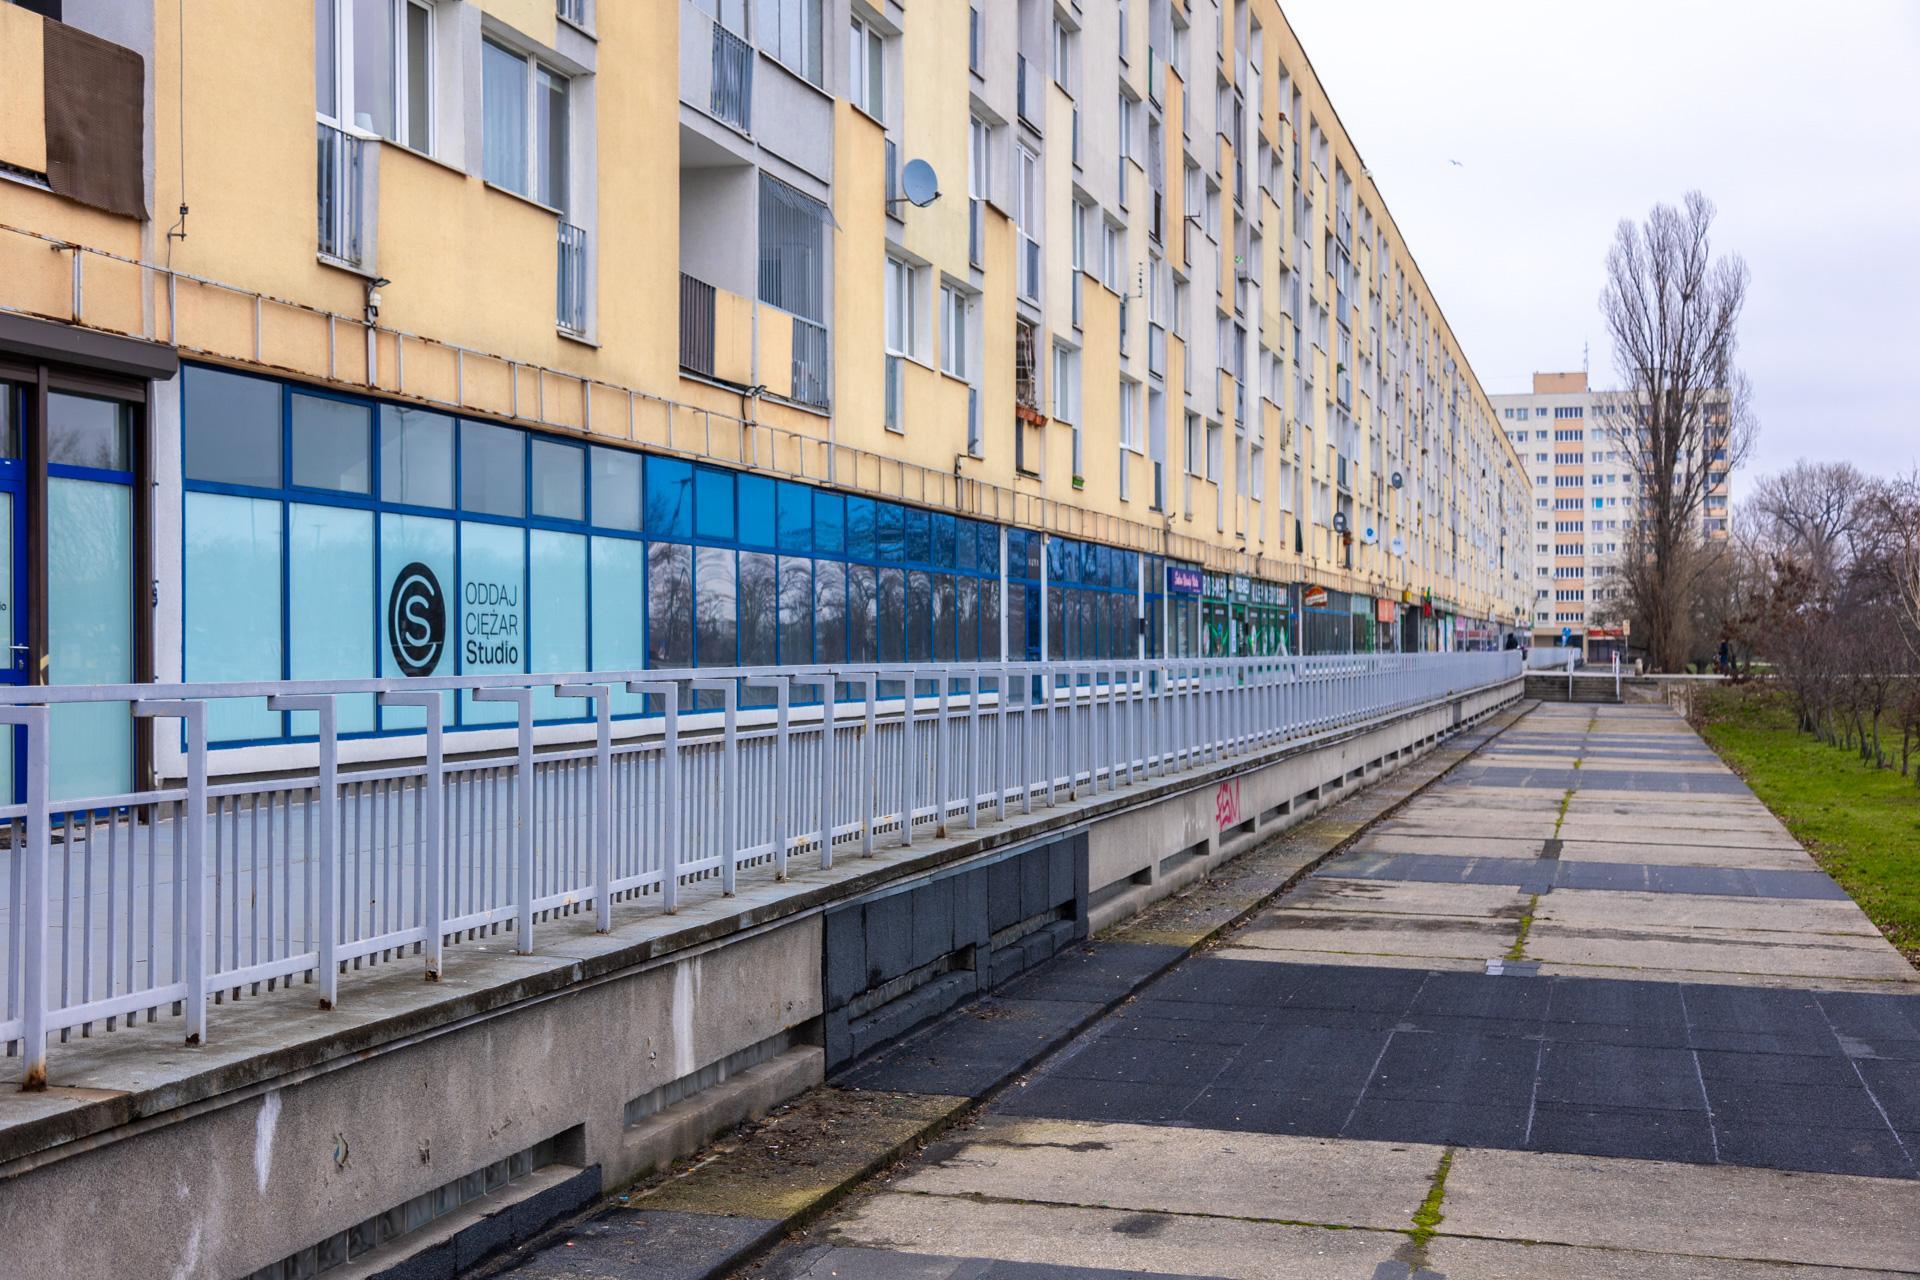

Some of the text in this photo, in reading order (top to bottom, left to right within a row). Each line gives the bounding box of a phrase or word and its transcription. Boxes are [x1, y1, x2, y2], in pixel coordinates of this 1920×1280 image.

[466, 582, 517, 607] ODDAJ
[466, 609, 518, 640] CIĘŻAR
[466, 640, 518, 664] Studio
